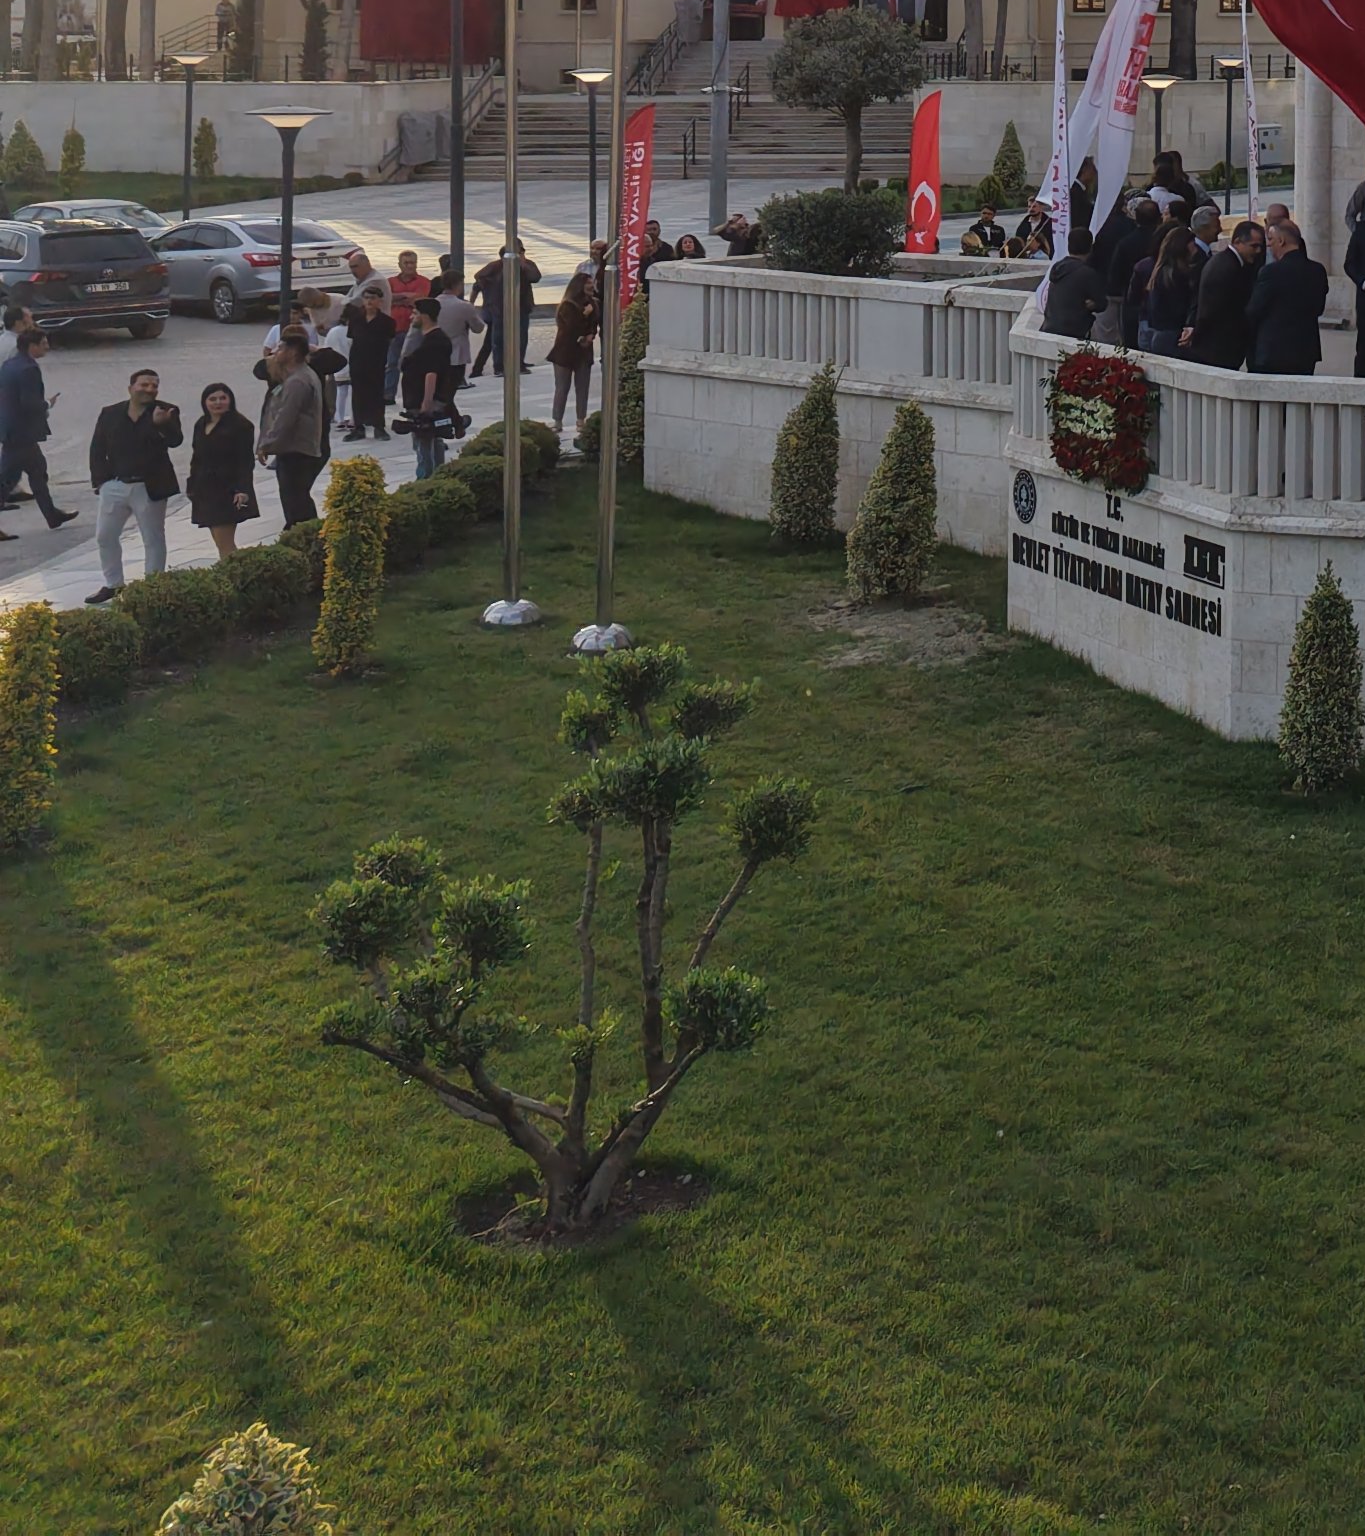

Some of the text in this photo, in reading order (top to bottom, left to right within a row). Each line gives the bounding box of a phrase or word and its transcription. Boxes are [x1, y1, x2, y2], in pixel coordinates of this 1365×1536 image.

[1013, 532, 1222, 637] DEVLET TİYATROLARI HATAY SAHNESİ
